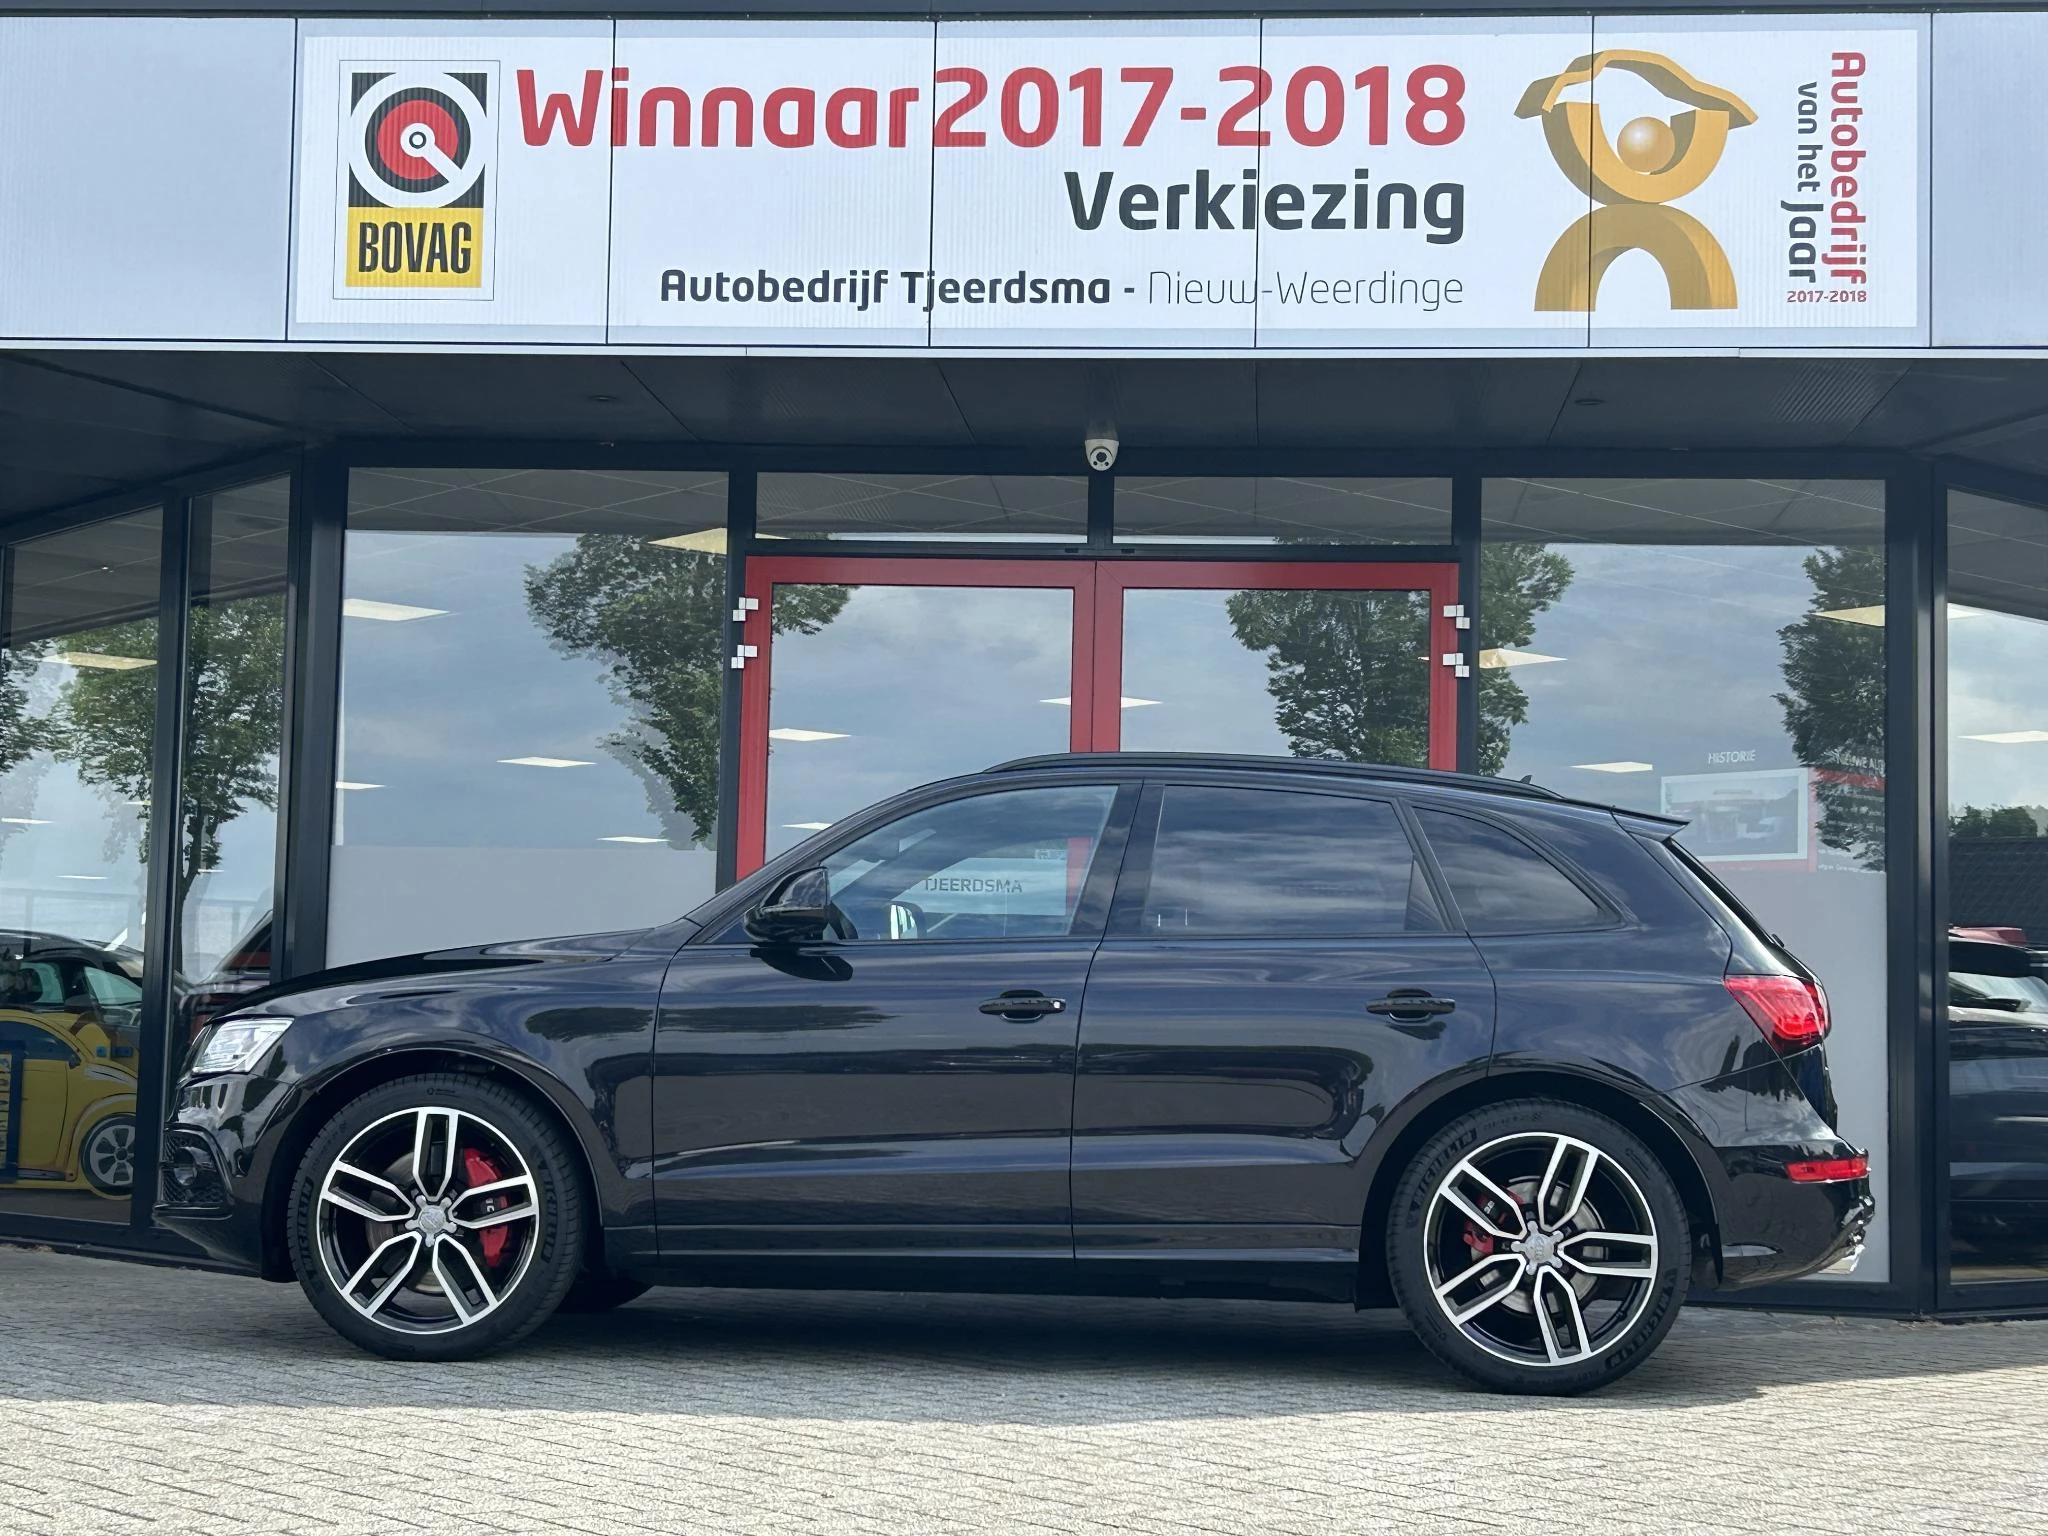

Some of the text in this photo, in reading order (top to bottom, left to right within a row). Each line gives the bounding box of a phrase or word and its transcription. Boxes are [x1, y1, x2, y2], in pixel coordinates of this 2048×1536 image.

[516, 64, 1467, 149] Winnaar 2017-2018
[1796, 81, 1818, 135] van
[1796, 145, 1824, 193] het
[1821, 51, 1867, 284] Autobedrijf
[1063, 168, 1466, 245] Verkiezing
[358, 221, 472, 274] BOVAG
[660, 268, 889, 312] Autobedrijf
[900, 269, 1111, 313] Tjeerdsma
[1148, 270, 1464, 312] Nieuw-Weerdinge
[1787, 289, 1868, 304] 2017-2018
[924, 877, 1023, 893] TJEERDSMA
